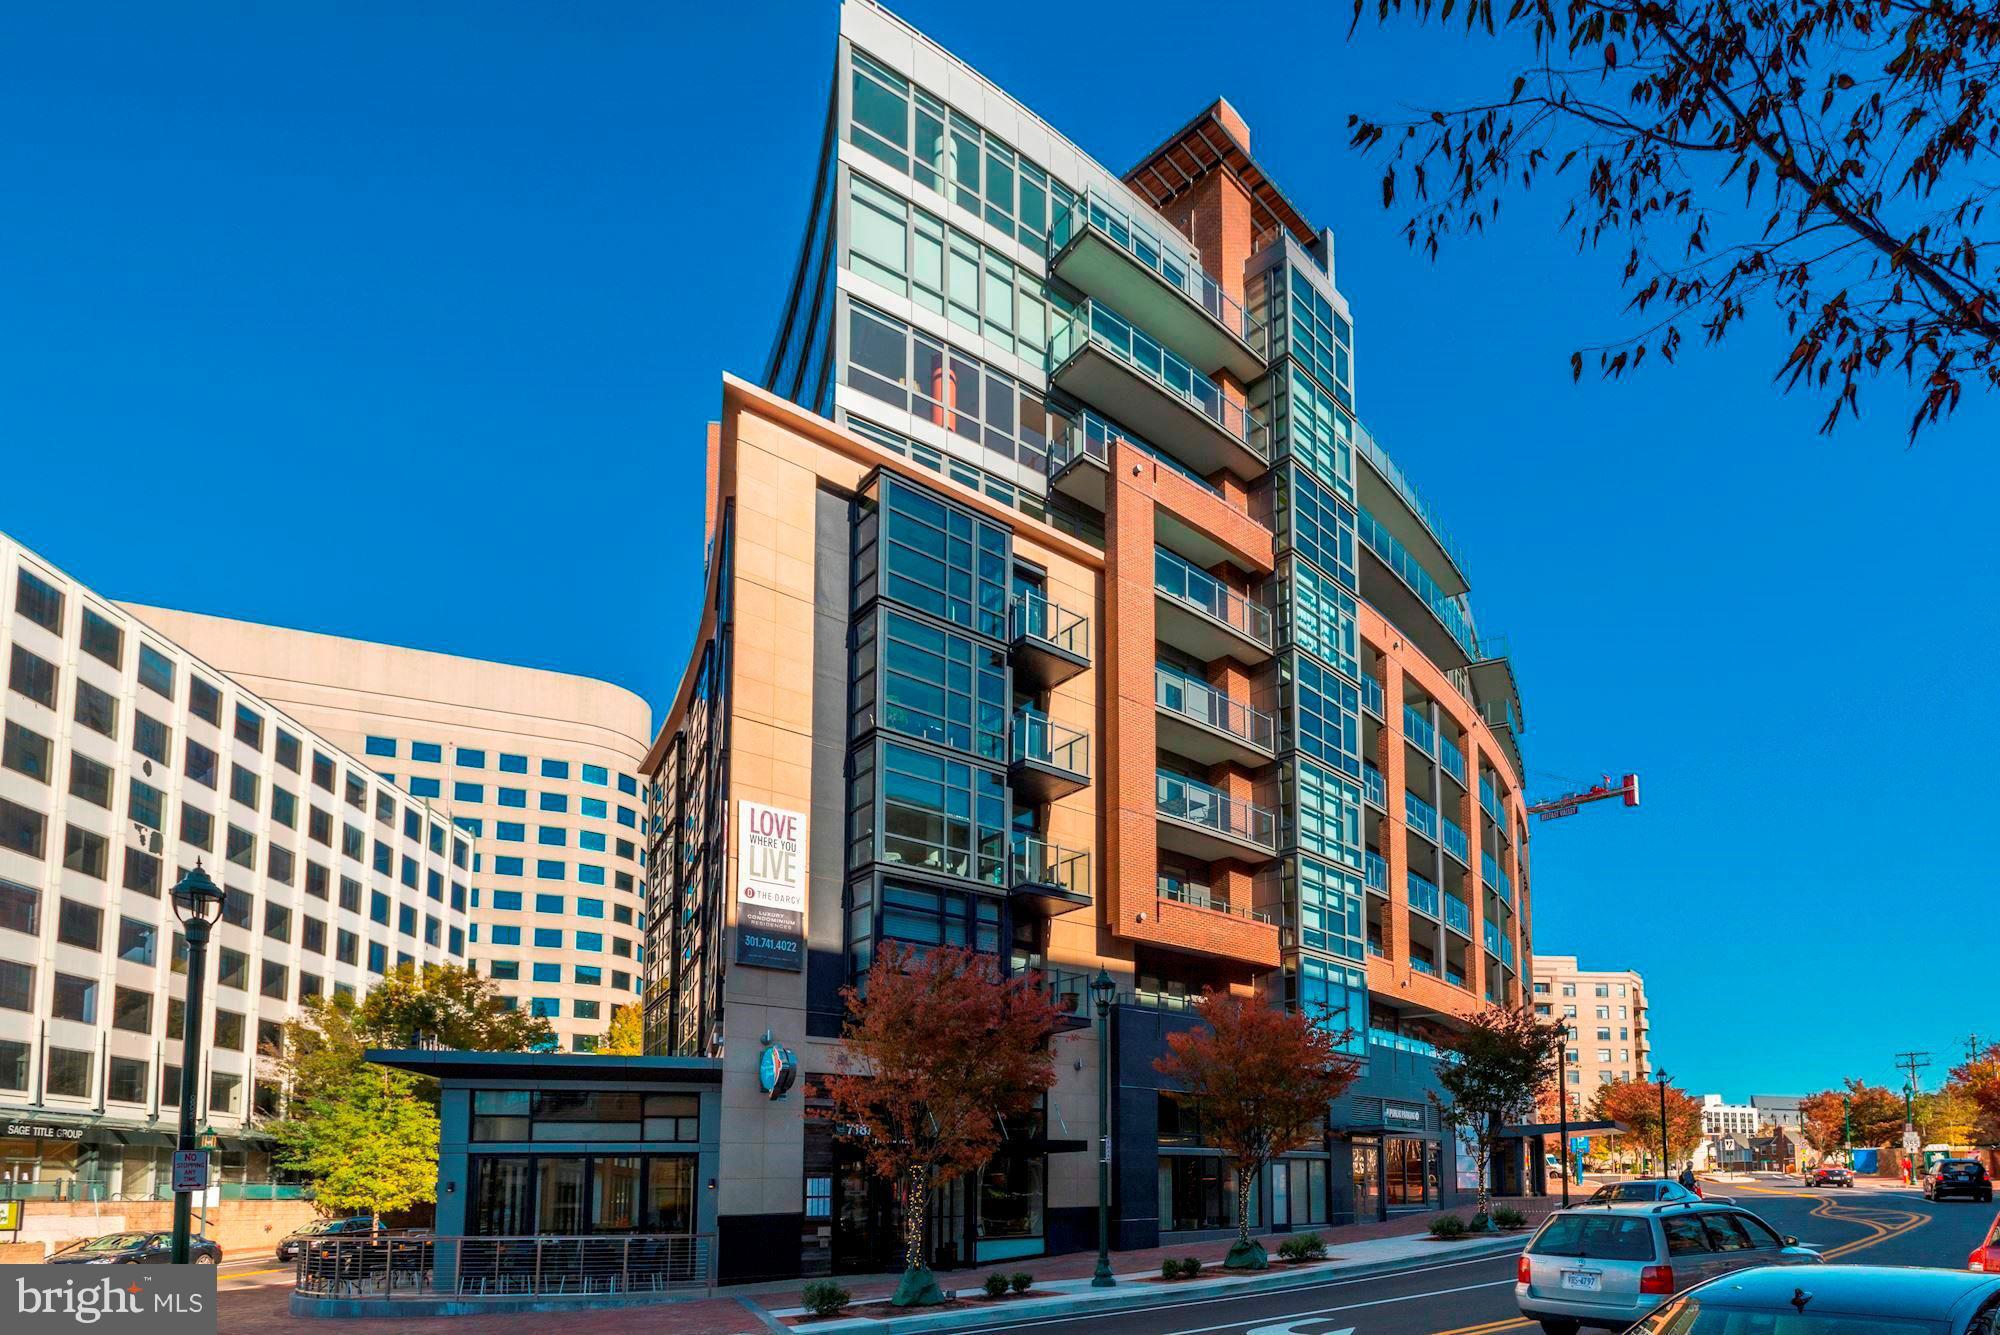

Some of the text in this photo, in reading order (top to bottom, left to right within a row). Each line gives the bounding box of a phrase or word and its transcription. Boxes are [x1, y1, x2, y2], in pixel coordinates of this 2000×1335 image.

[751, 808, 797, 842] LOVE
[750, 834, 797, 853] WHERE YOU
[750, 845, 796, 883] LIVE
[757, 890, 772, 901] THE
[775, 893, 800, 905] DARCY
[747, 913, 796, 926] CONDOMINIUM
[758, 911, 785, 919] LUXURY
[751, 920, 792, 930] RESIDENCES
[745, 935, 797, 953] 301.741.4022
[8, 1125, 83, 1139] SAGE TITLE GROUP
[184, 1153, 197, 1162] NO
